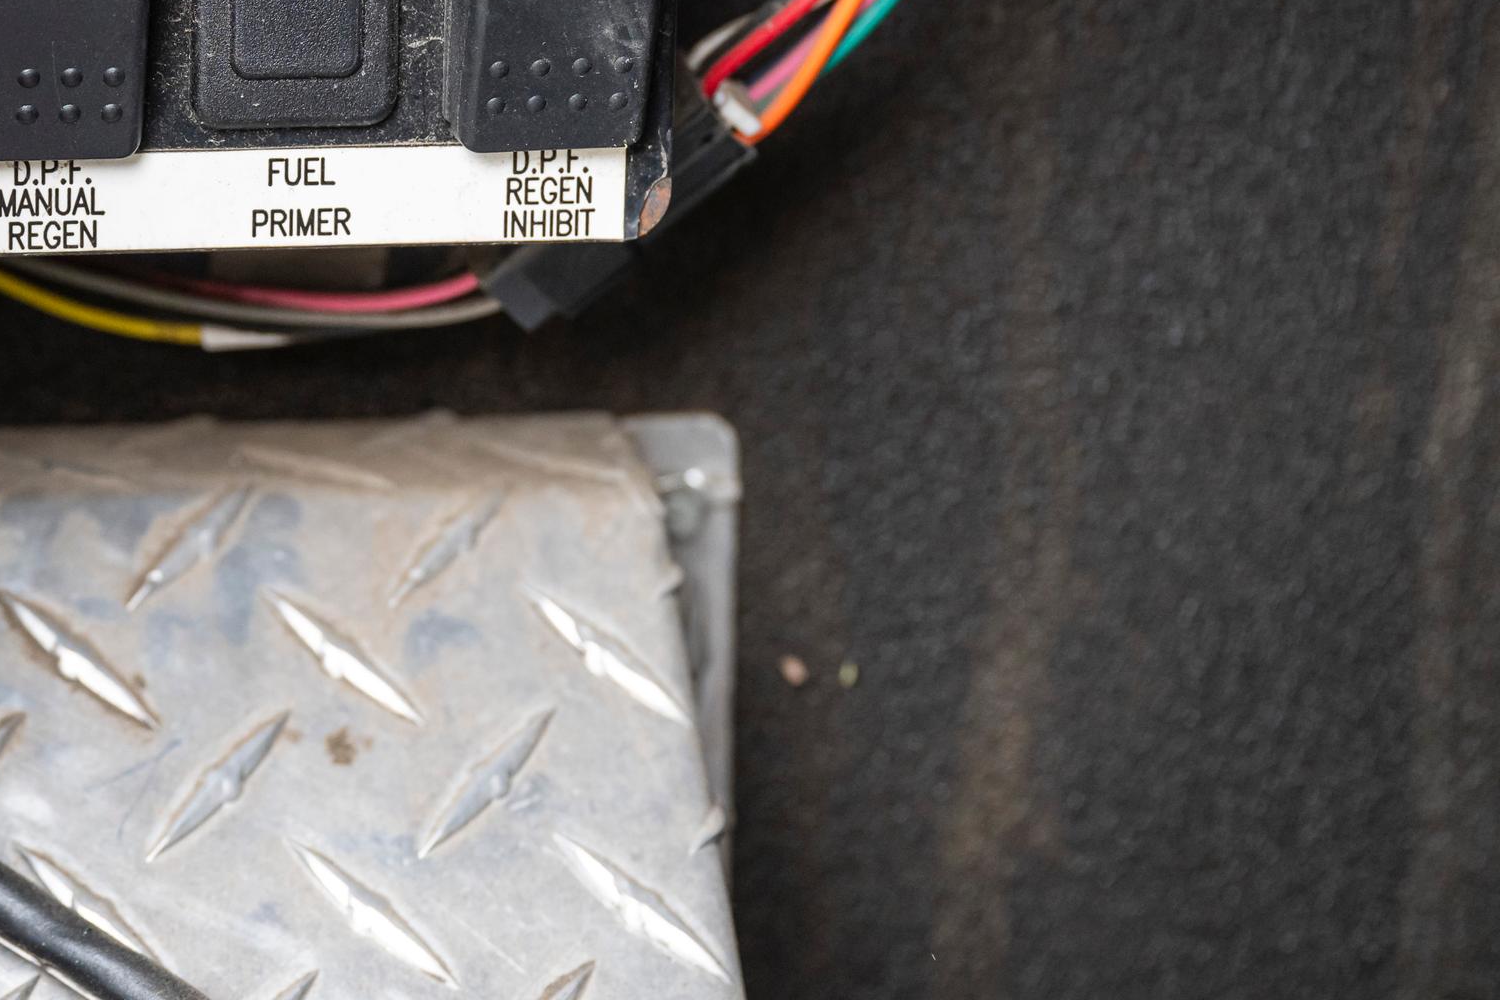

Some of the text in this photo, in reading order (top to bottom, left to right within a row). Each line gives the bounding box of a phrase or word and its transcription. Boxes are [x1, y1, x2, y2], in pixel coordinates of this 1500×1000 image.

[13, 159, 92, 185] D.P.F.
[267, 157, 336, 187] FUEL
[512, 149, 589, 175] D.P.F.
[506, 175, 593, 206] REGEN
[8, 219, 98, 250] REGEN
[251, 207, 352, 238] PRIMER
[503, 208, 596, 239] INHIBIT
